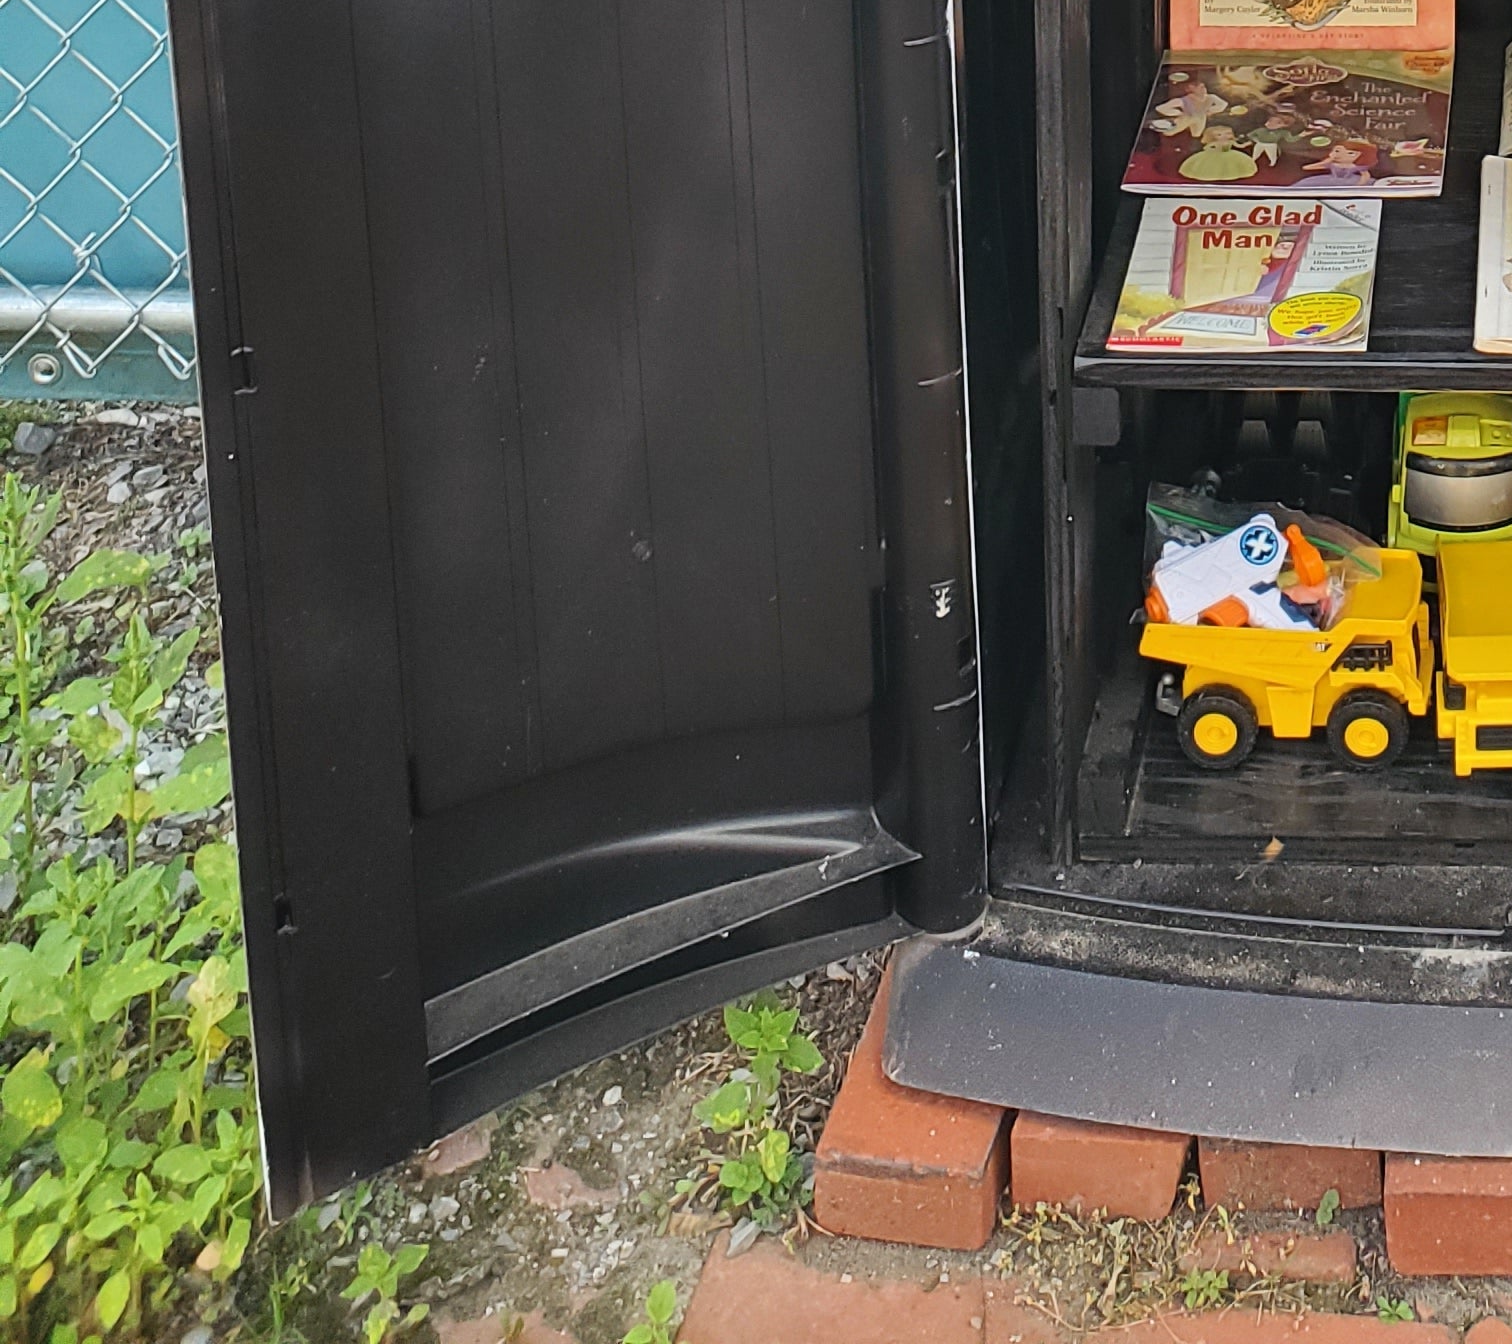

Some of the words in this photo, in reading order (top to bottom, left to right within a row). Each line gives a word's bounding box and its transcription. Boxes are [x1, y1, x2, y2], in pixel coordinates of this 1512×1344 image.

[1361, 82, 1392, 94] The
[1310, 90, 1434, 104] Enchanted
[1329, 102, 1417, 117] Science
[1364, 116, 1408, 131] Fair
[1171, 204, 1239, 227] One
[1247, 204, 1323, 227] Glad
[1202, 229, 1274, 250] Man
